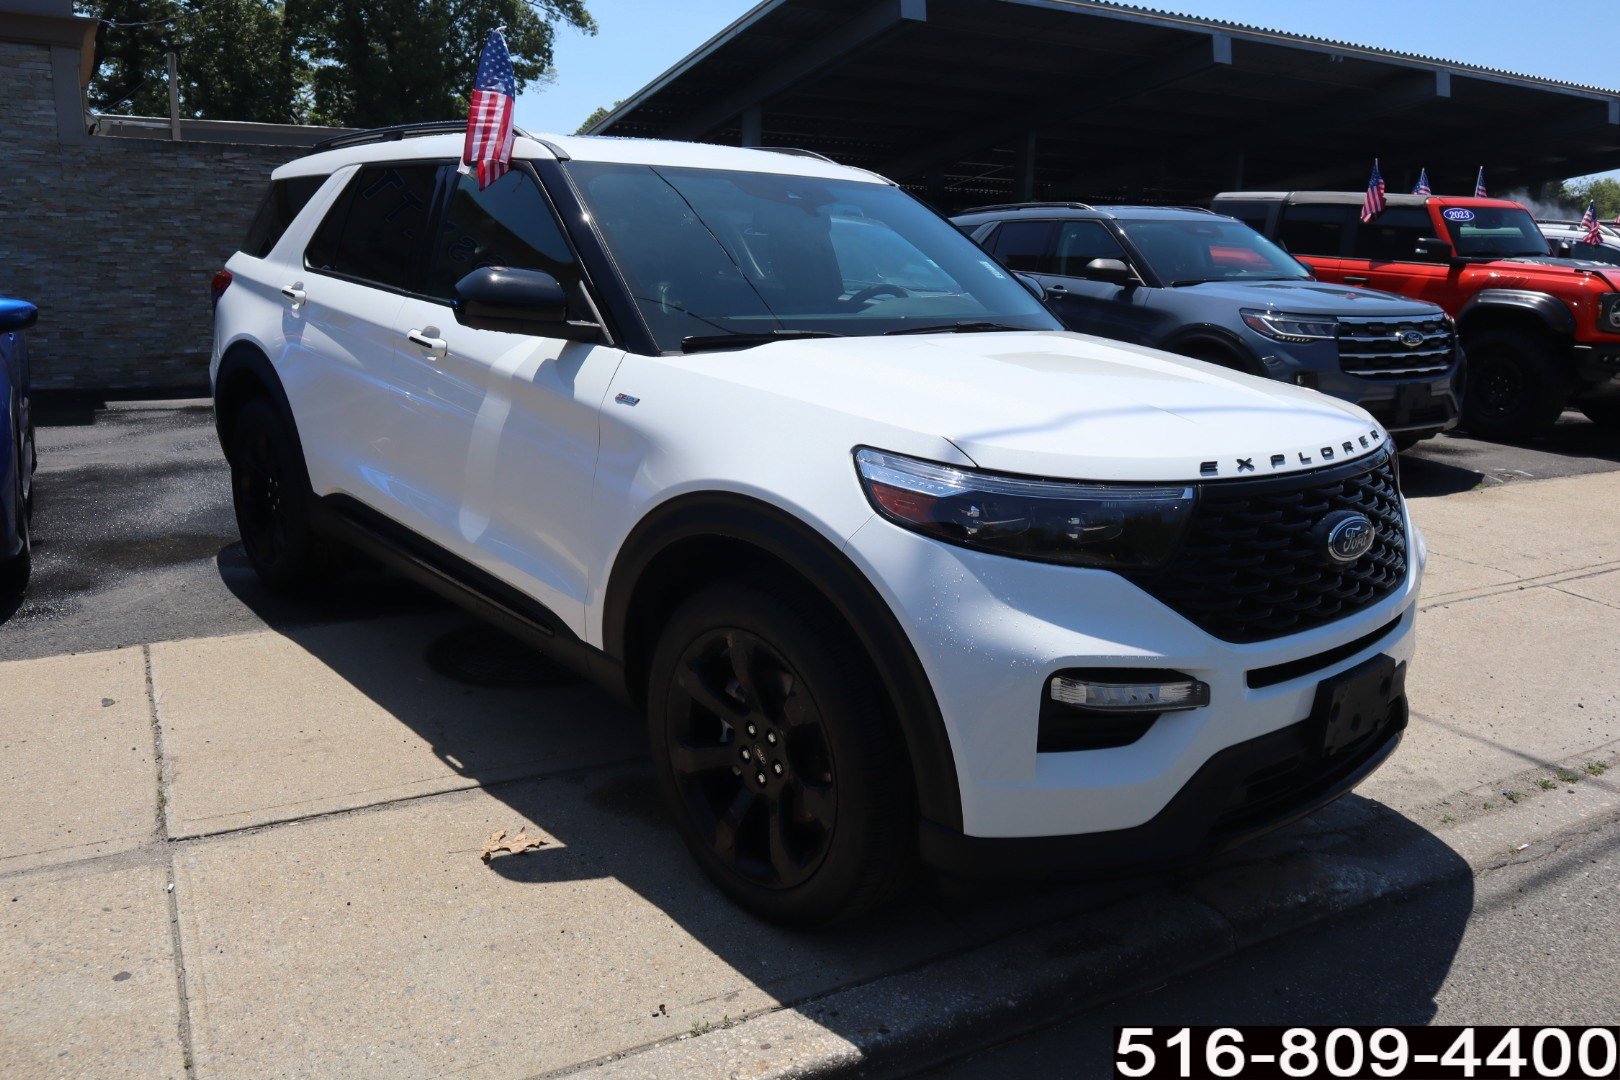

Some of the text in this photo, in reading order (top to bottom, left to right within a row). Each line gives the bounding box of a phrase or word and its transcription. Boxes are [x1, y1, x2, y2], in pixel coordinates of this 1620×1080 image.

[1449, 210, 1470, 219] 2023
[1199, 429, 1380, 473] EXPLORER
[1343, 525, 1369, 552] Ford
